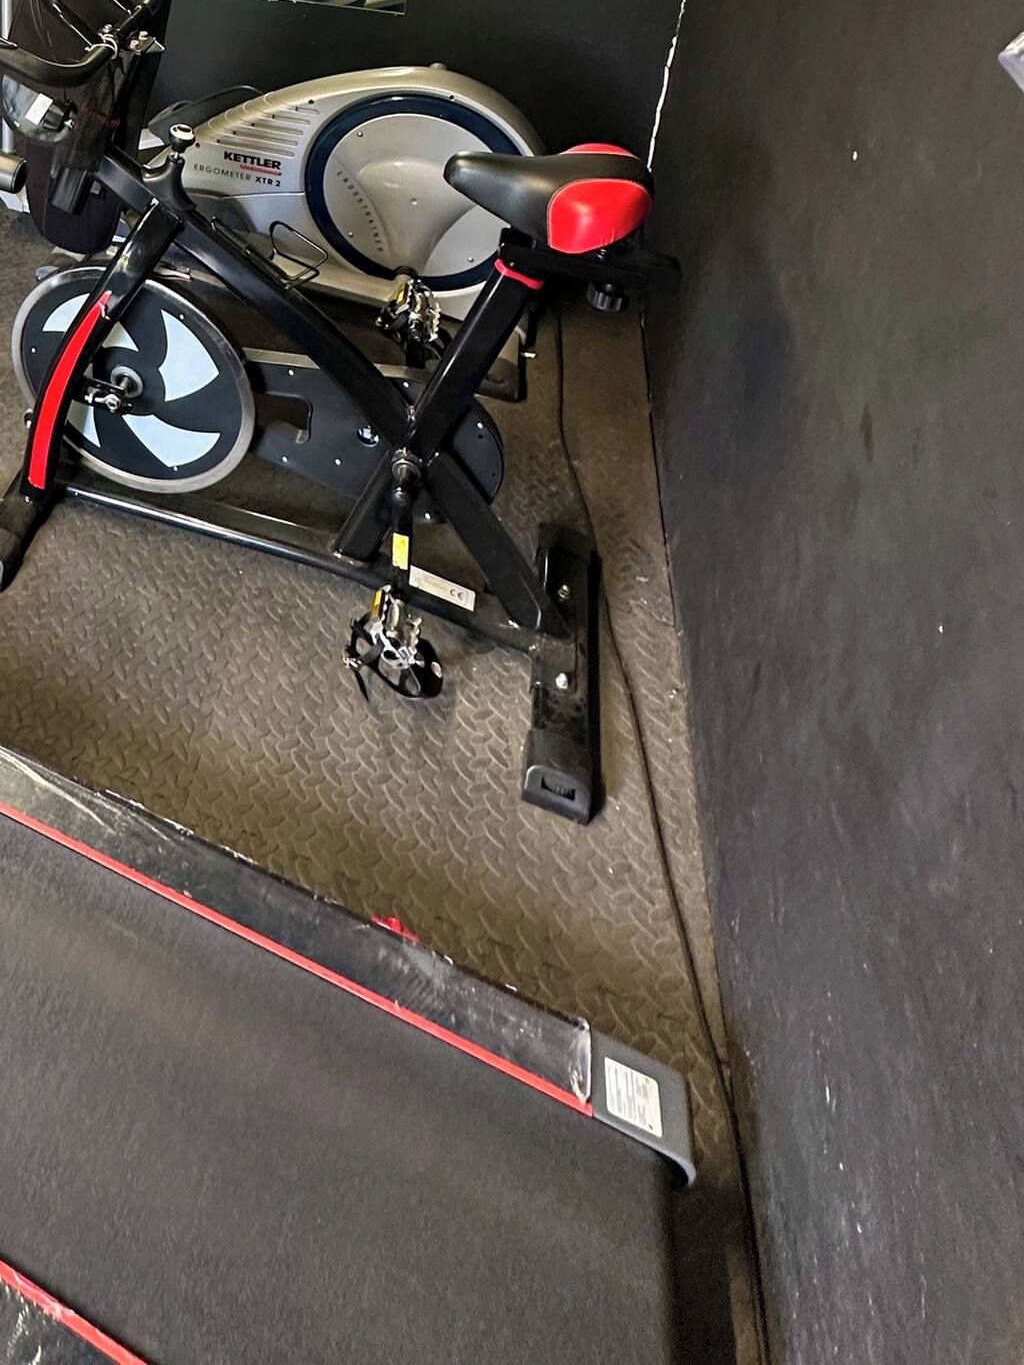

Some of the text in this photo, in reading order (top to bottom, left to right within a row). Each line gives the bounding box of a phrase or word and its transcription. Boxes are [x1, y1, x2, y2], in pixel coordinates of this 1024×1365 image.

[223, 150, 282, 170] KETTLER
[193, 163, 252, 181] ERGOMETER
[255, 176, 274, 188] XTR
[275, 180, 281, 188] 2
